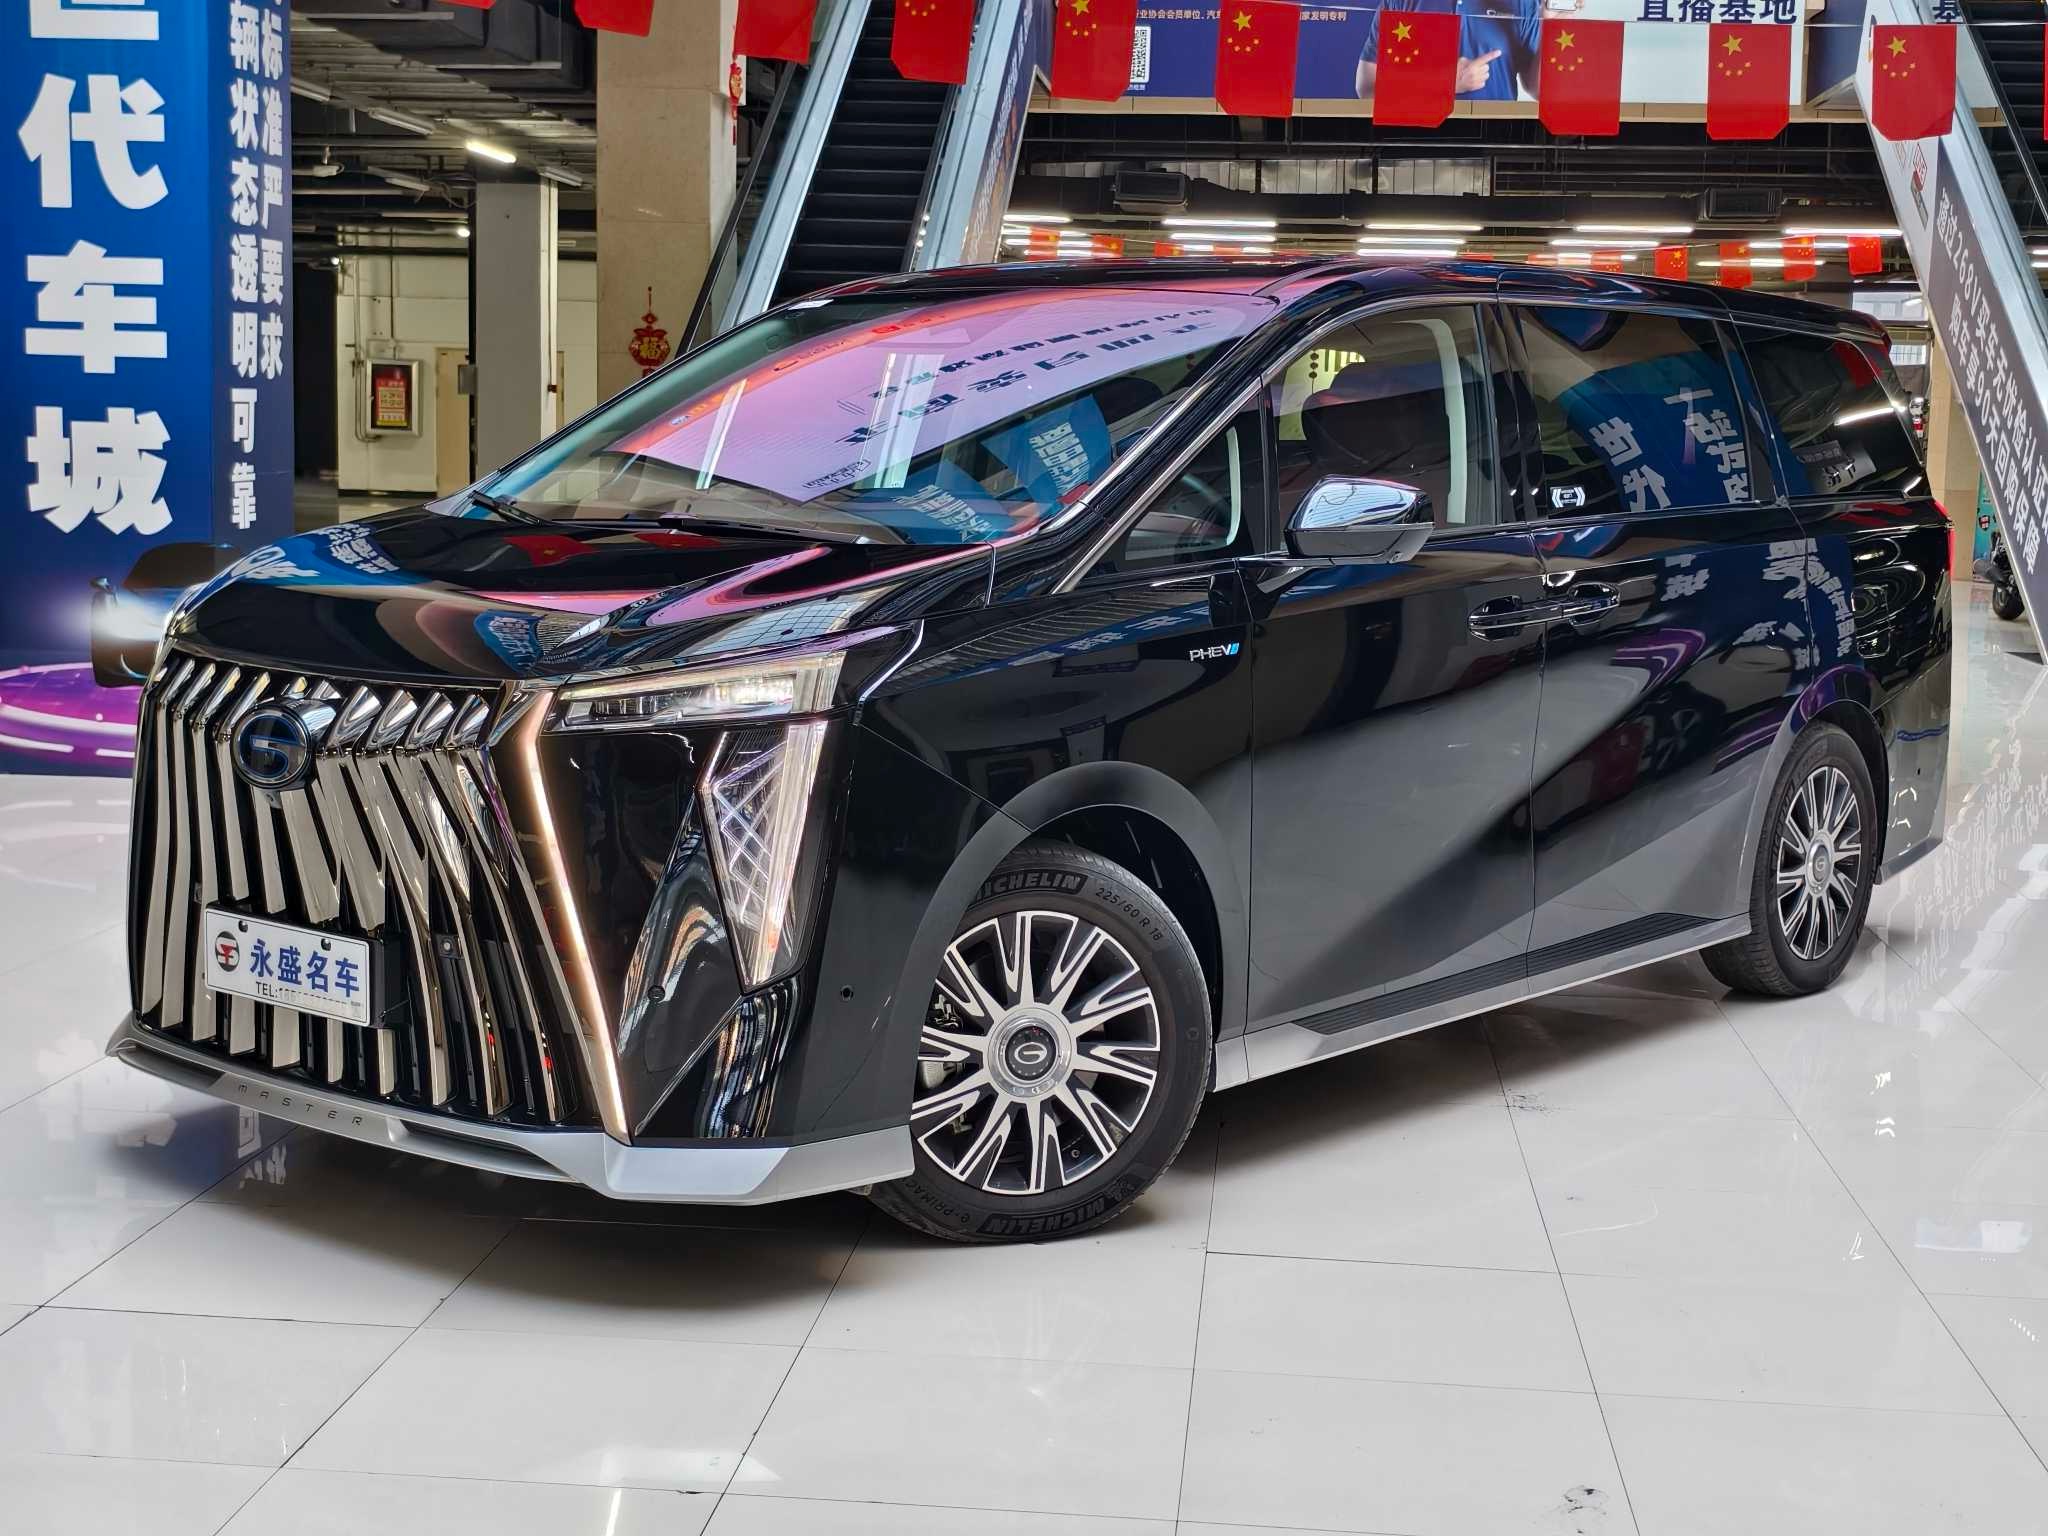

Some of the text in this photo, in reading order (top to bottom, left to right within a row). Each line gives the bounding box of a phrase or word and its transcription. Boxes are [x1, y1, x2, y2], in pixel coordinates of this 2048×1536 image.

[1299, 11, 1347, 22] 家发明专利
[261, 0, 284, 379] 标准严要求
[1937, 187, 2048, 546] 通过268V买车无忧检认证
[1189, 643, 1232, 662] PHEV
[1095, 886, 1141, 919] 225/60
[250, 938, 360, 998] 永盛名车
[238, 1083, 363, 1126] MASTER
